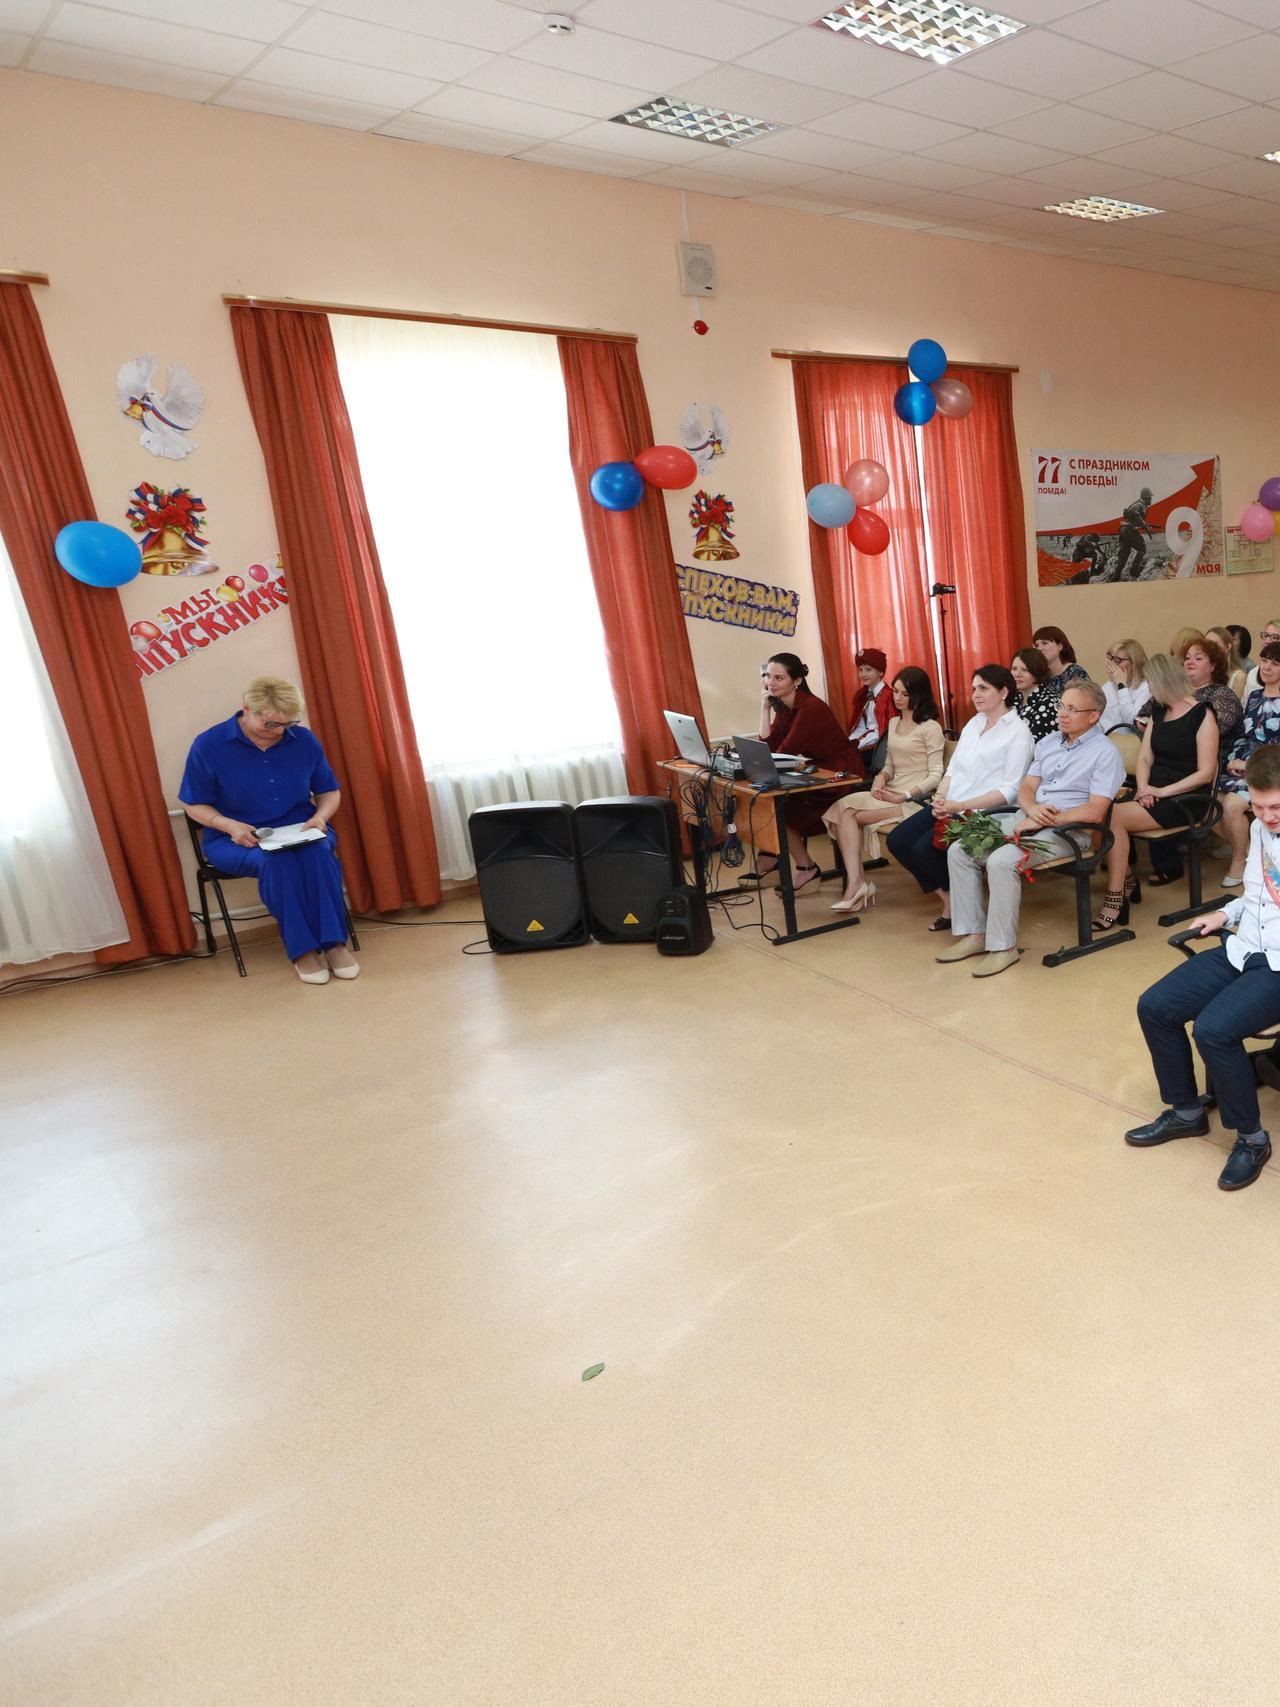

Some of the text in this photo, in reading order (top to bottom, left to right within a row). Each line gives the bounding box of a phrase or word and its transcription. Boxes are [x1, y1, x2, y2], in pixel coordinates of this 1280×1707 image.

[1038, 456, 1061, 484] 77
[1069, 459, 1150, 472] С ПРАЗДНИКОМ
[1038, 487, 1067, 495] ПОБЕДА!
[1070, 475, 1118, 487] ПОБЕДЫ!
[1165, 506, 1204, 578] 9
[162, 588, 220, 625] МЫ
